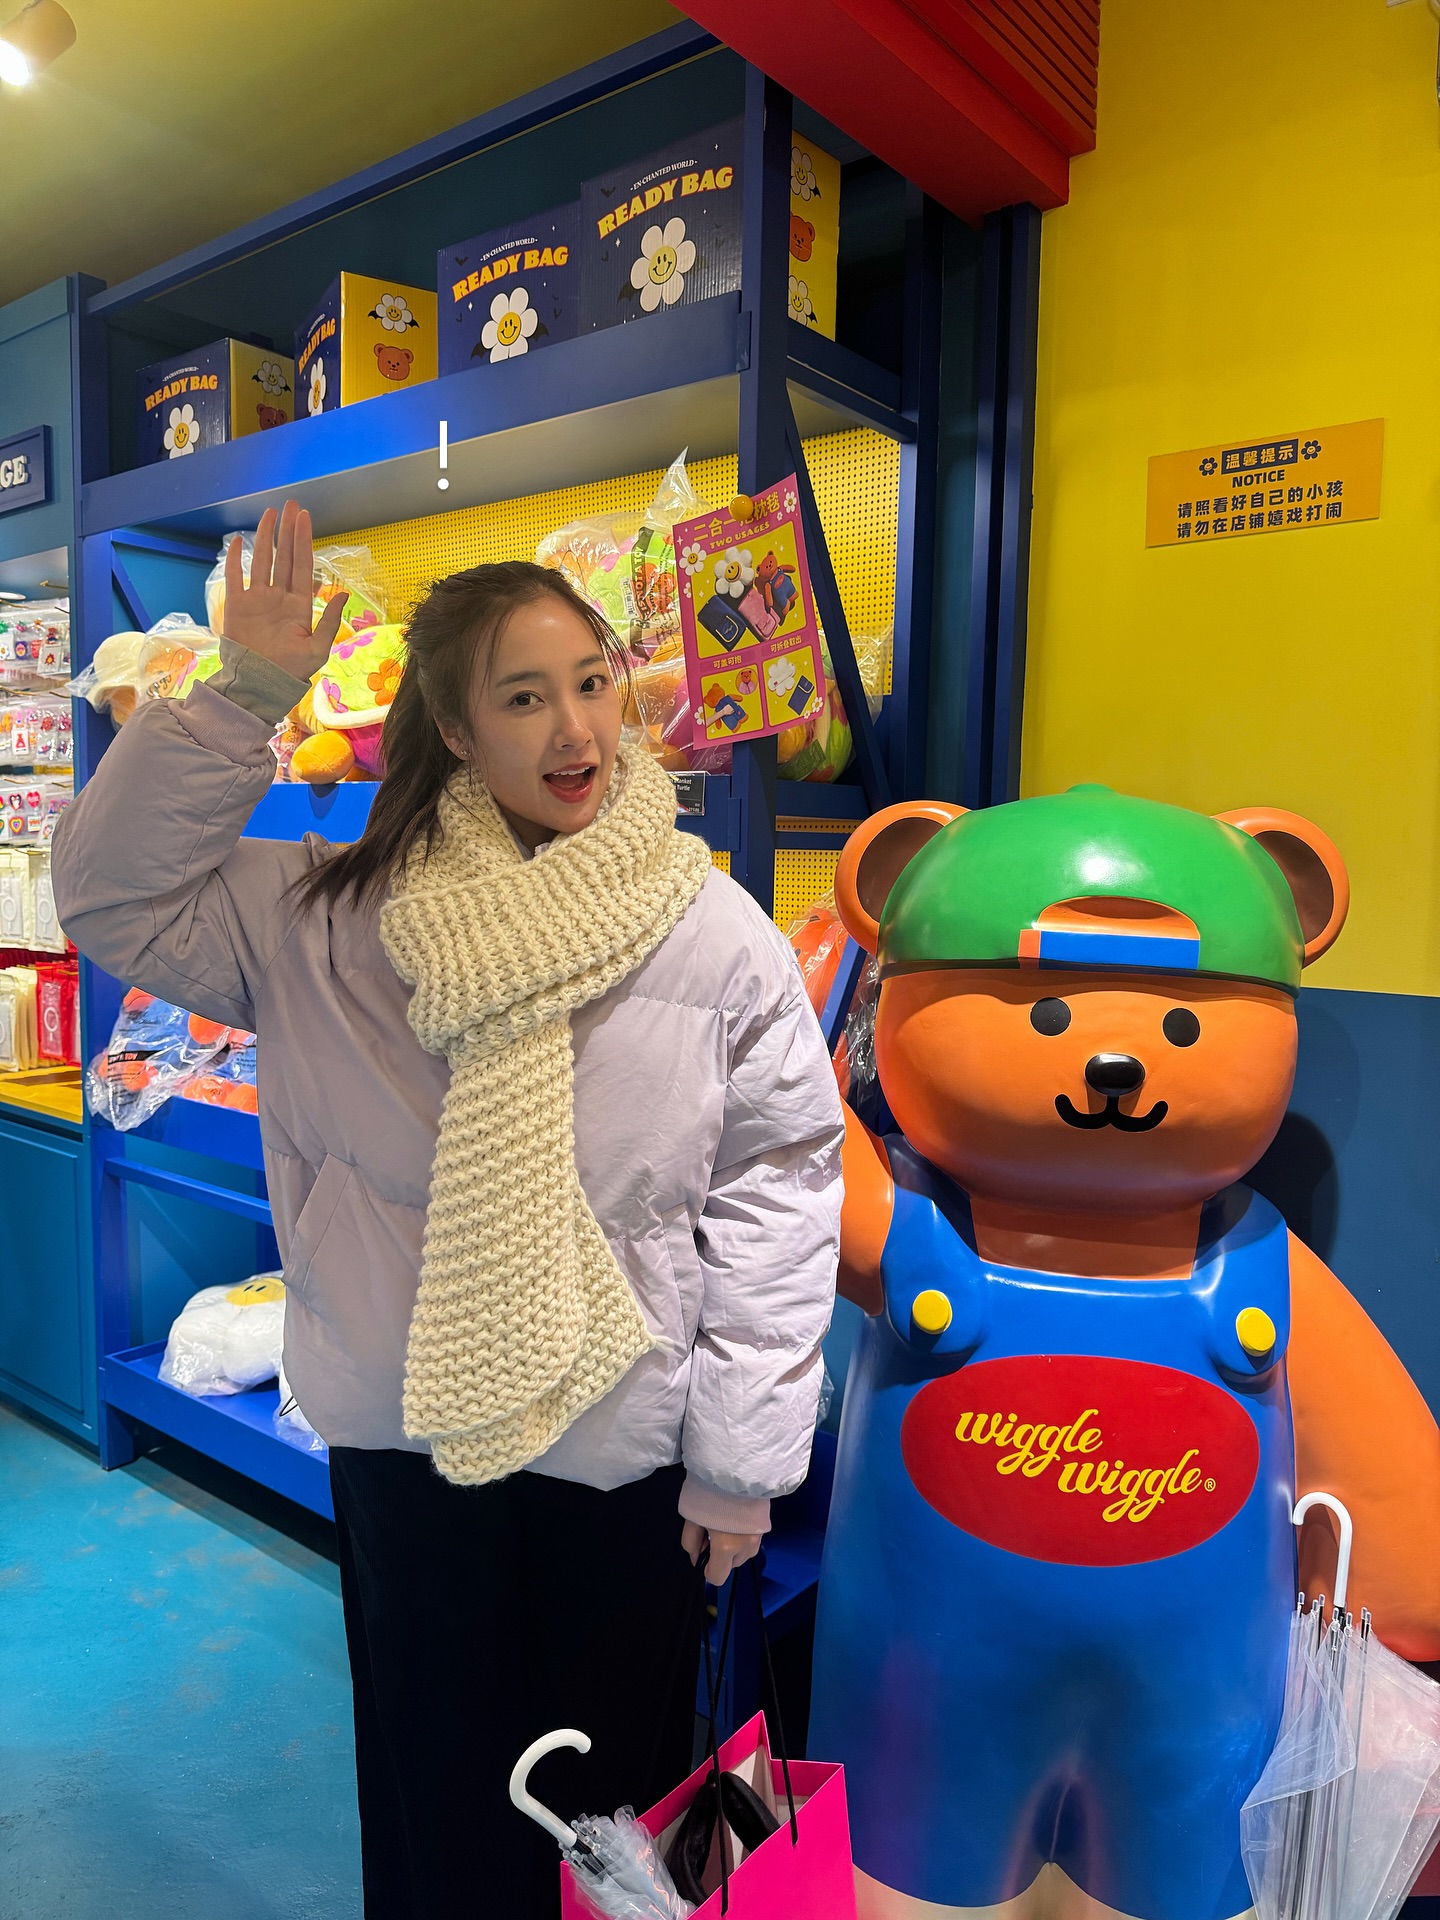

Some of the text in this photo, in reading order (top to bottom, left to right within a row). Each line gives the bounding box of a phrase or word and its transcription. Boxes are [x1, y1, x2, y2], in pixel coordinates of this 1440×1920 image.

[671, 159, 694, 171] WORLD
[597, 166, 734, 240] READY BAG
[451, 245, 568, 303] READY BAG
[298, 327, 320, 375] READY
[320, 317, 336, 342] BAG
[144, 377, 189, 412] READY
[190, 374, 218, 391] BAG
[0, 455, 28, 488] GE
[1225, 444, 1294, 470] 温馨提示
[1232, 469, 1285, 488] NOTICE
[1177, 480, 1344, 519] 请照看好自己的小孩
[709, 521, 770, 549] TWO USAGES
[1177, 501, 1343, 539] 请勿在店铺嬉戏打闹
[634, 565, 643, 574] A
[634, 575, 644, 600] NOT
